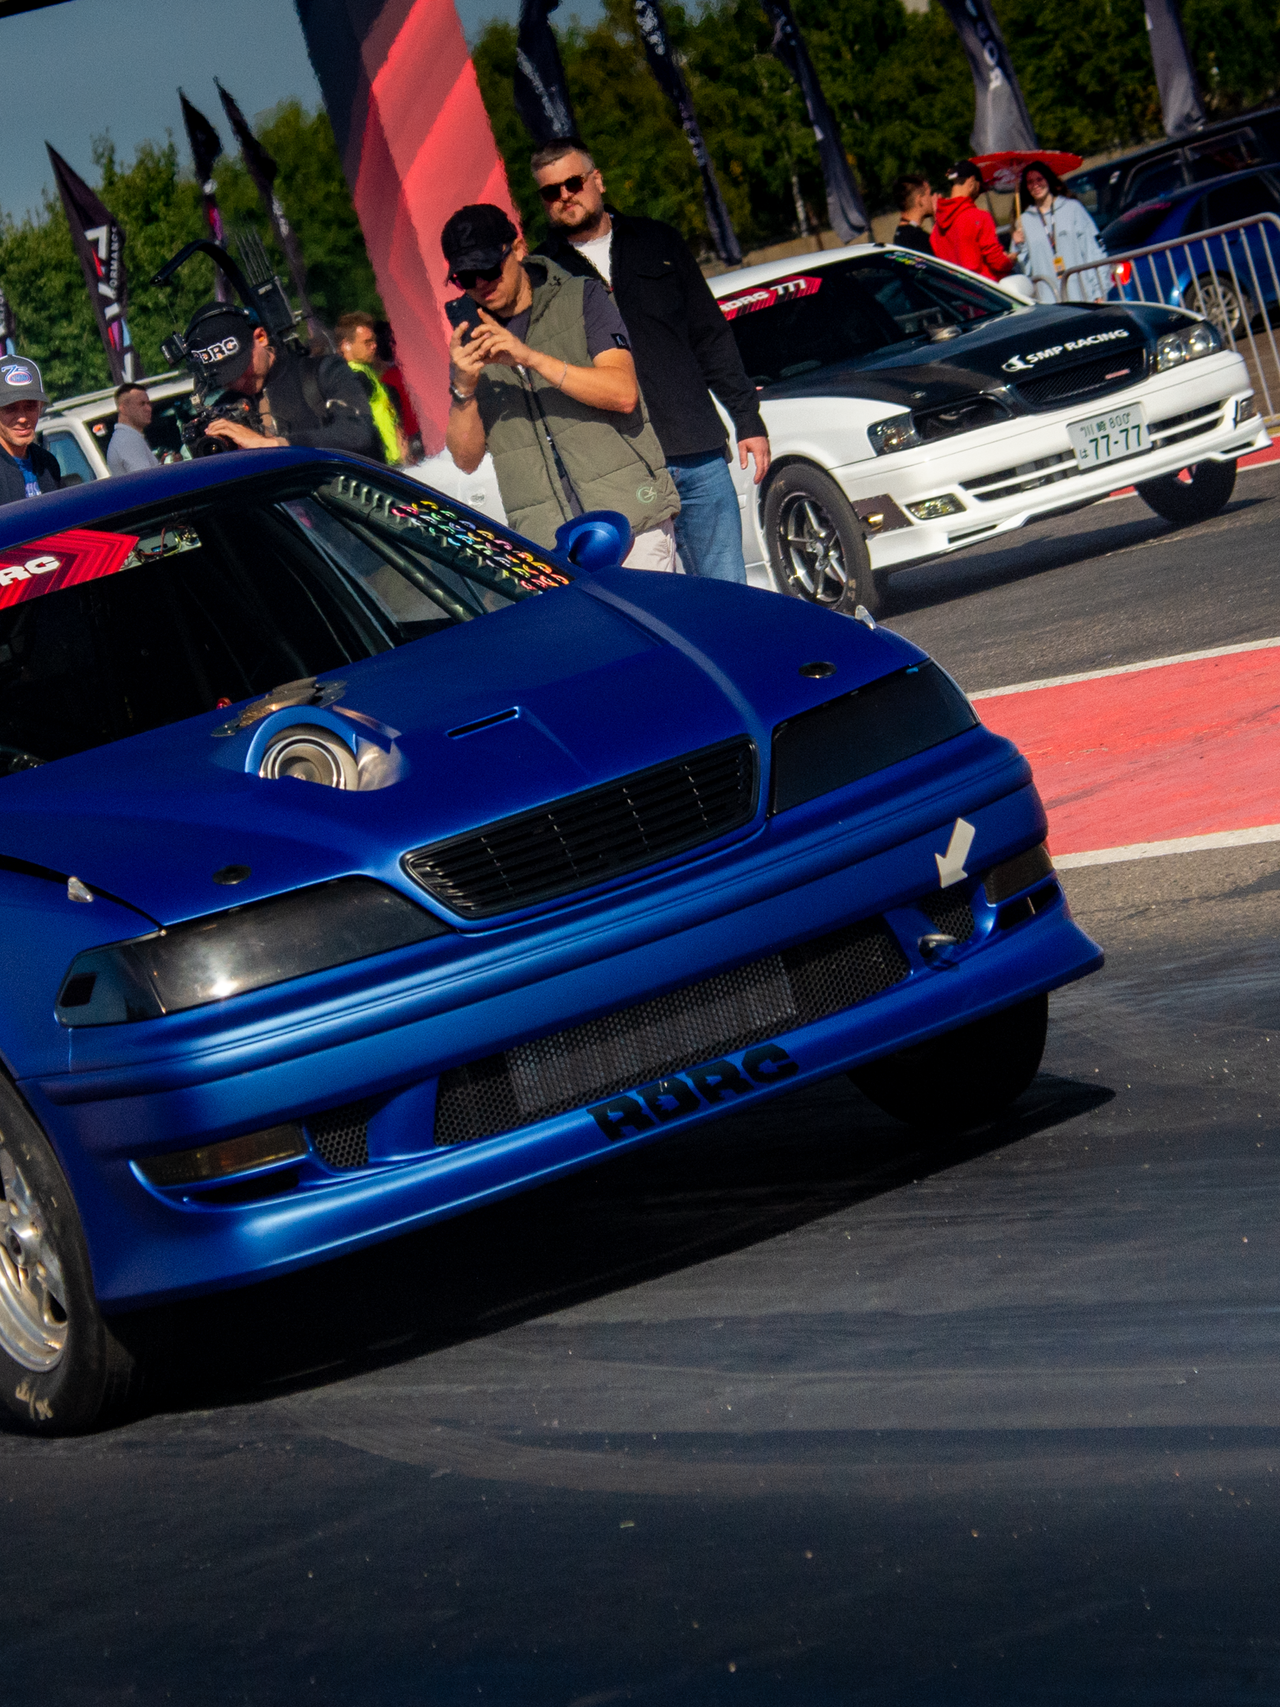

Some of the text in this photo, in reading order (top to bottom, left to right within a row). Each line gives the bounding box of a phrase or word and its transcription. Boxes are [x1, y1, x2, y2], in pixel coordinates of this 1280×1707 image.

[770, 278, 807, 295] 777
[1026, 328, 1130, 363] SMP RACING
[1109, 413, 1130, 429] 800
[1089, 423, 1141, 460] 77-77
[586, 1043, 799, 1142] RDRC
